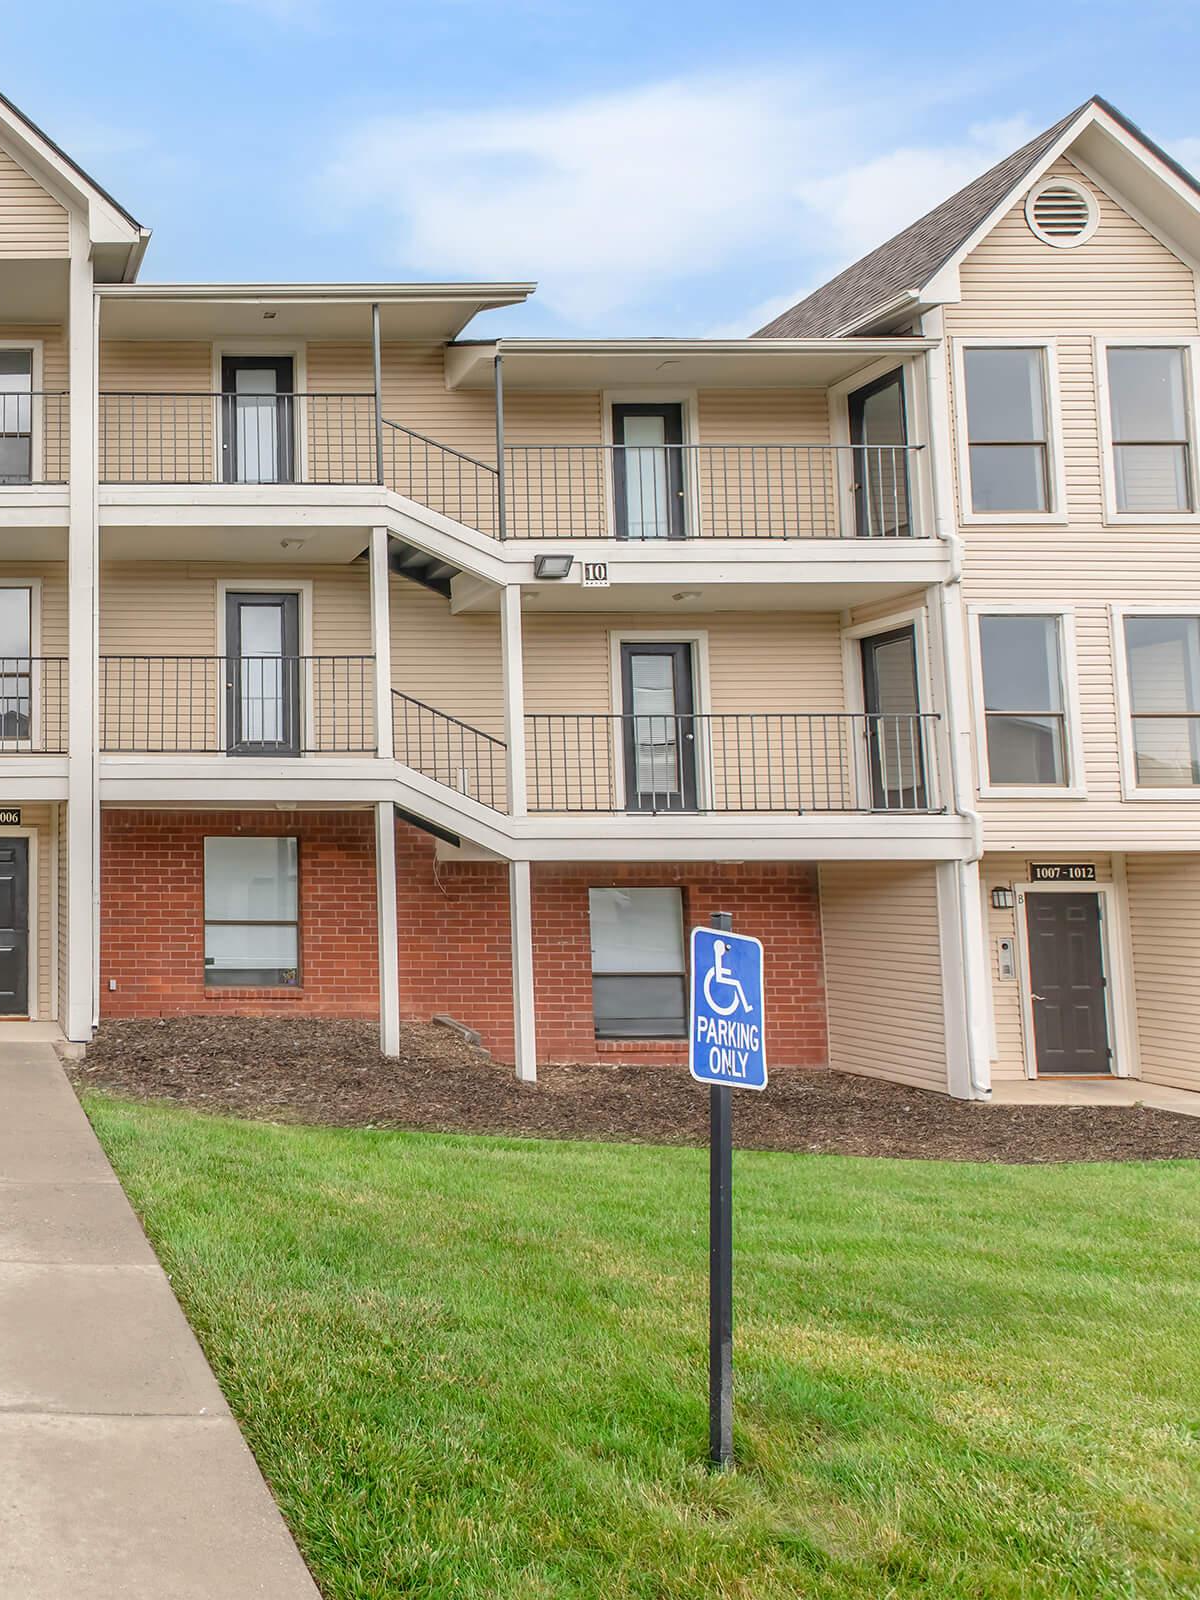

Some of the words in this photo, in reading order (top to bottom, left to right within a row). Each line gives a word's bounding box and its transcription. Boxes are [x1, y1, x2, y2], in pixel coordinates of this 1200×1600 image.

[586, 564, 605, 580] 10
[697, 1015, 760, 1052] PARKING
[709, 1046, 749, 1078] ONLY
